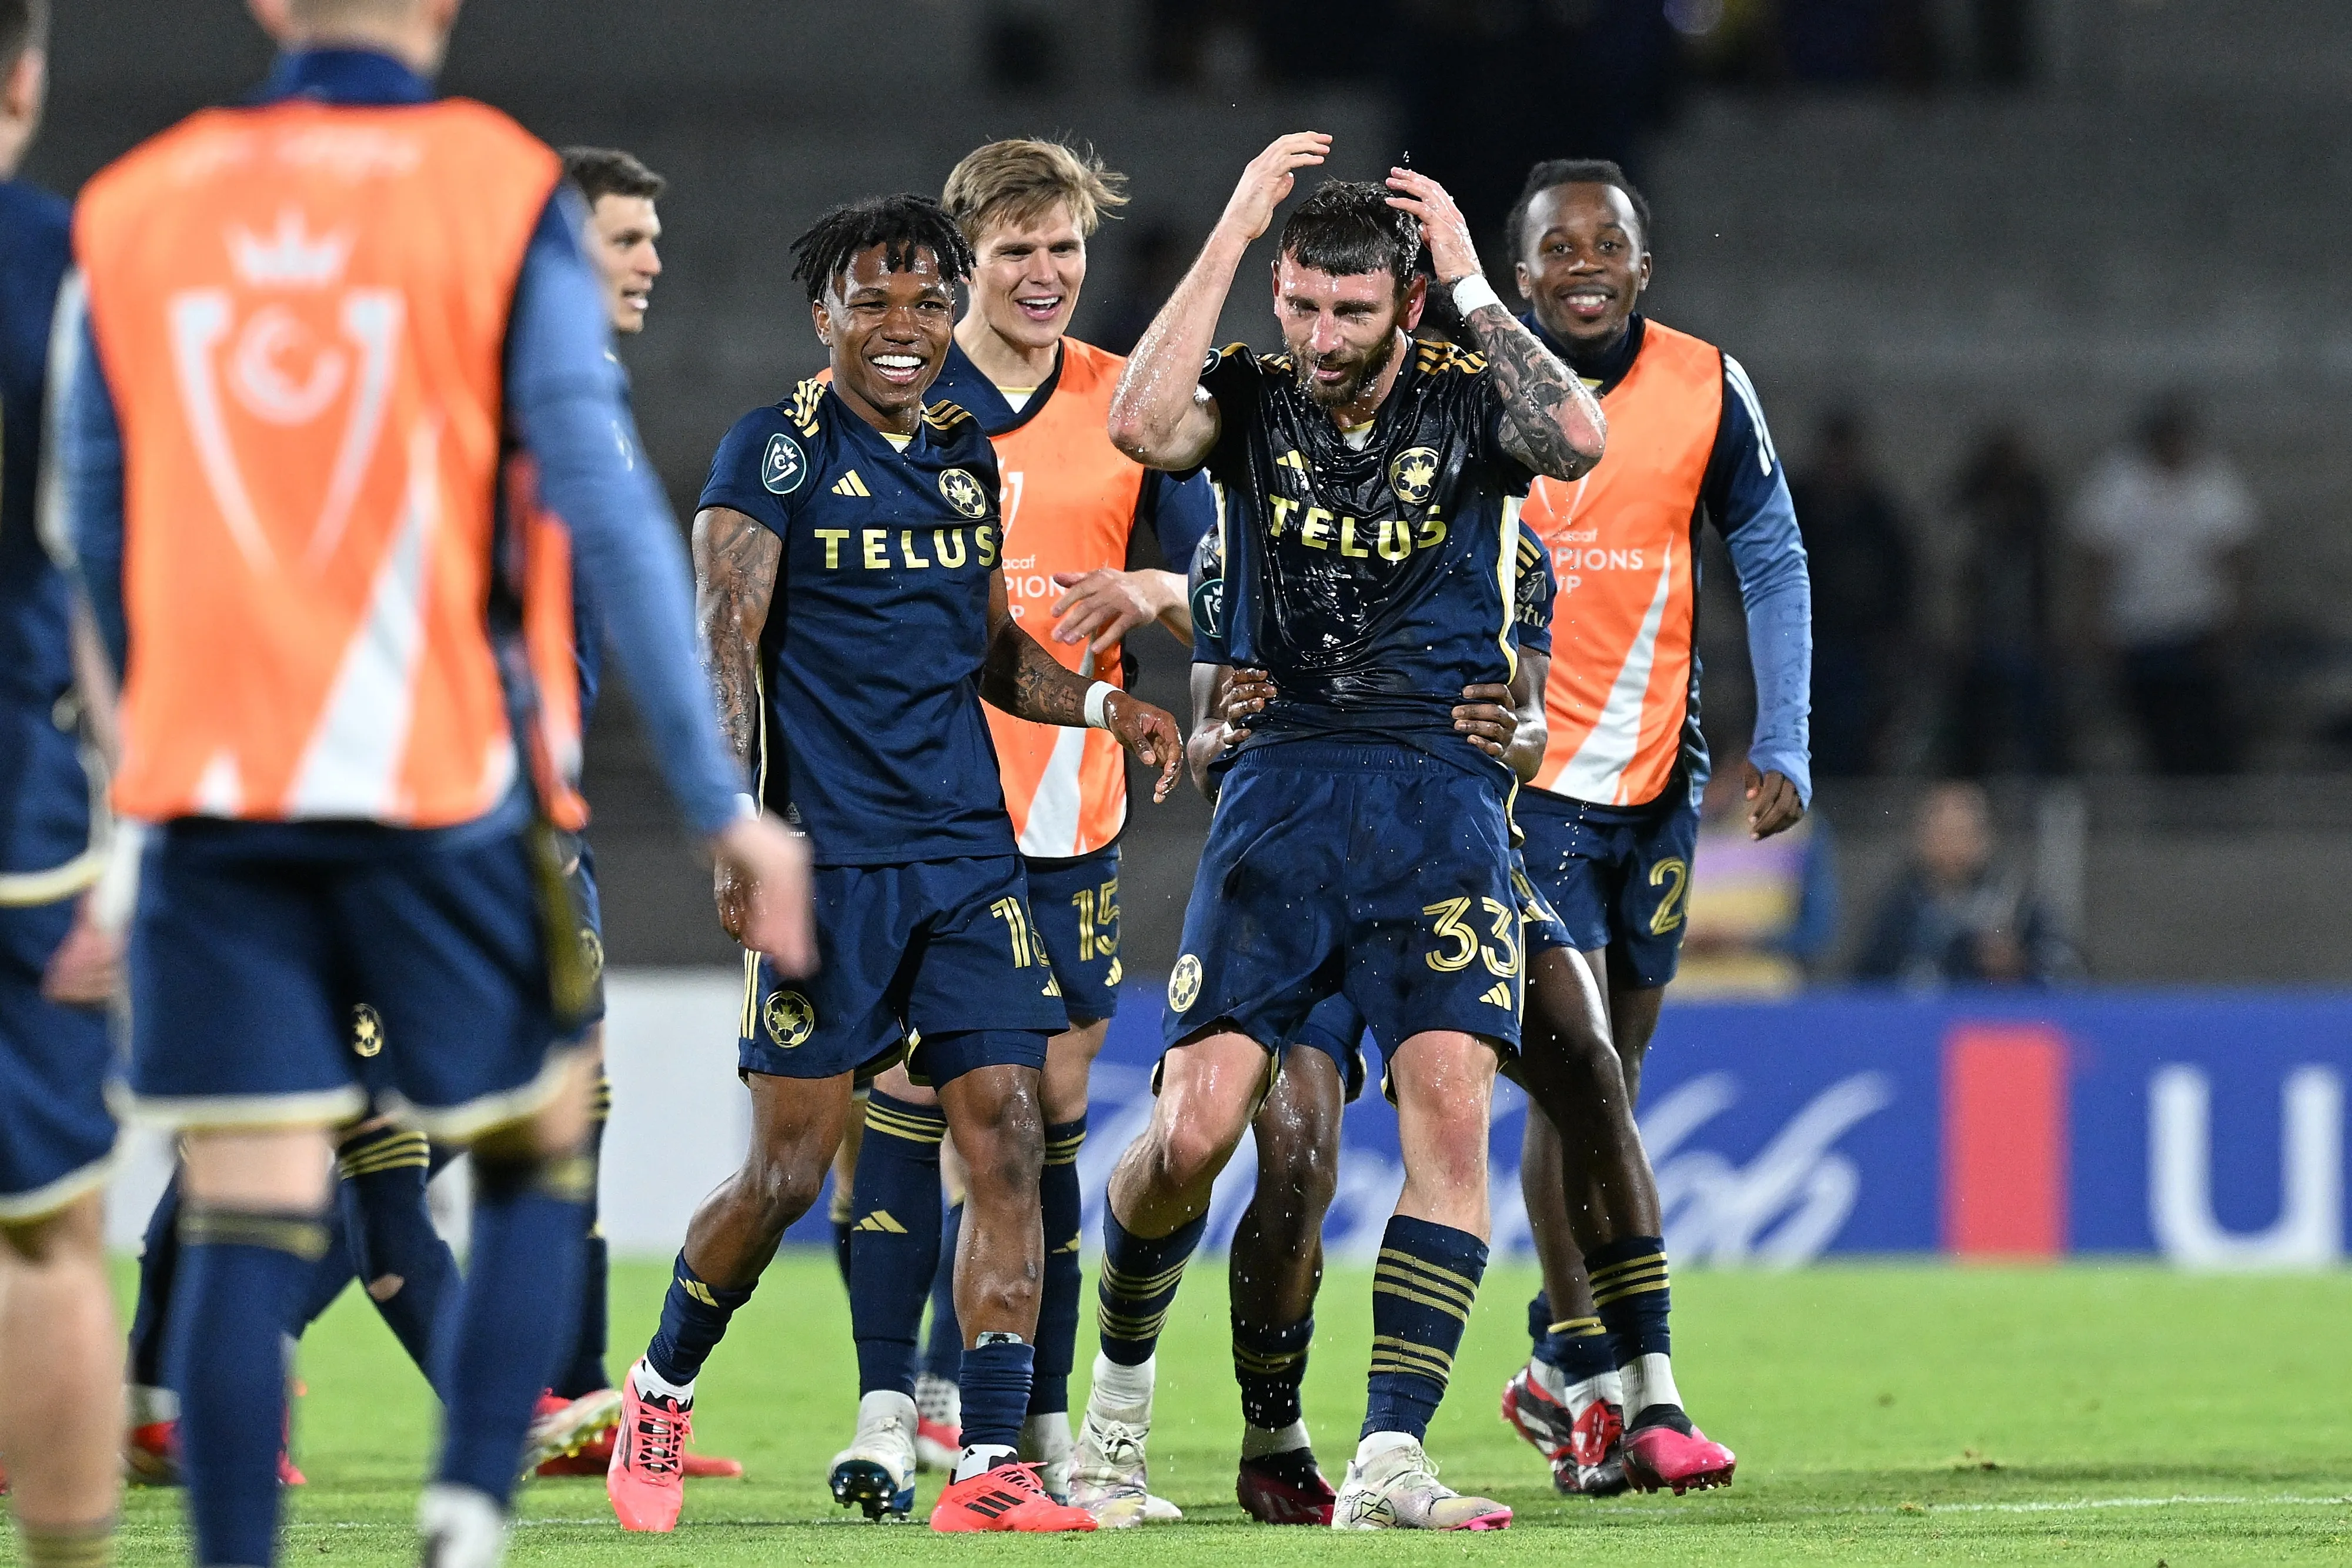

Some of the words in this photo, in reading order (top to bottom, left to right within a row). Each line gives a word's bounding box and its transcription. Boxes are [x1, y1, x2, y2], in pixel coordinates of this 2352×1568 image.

[814, 525, 995, 569] TELUS
[1269, 494, 1447, 561] TELUS
[1072, 877, 1120, 961] 15
[1649, 857, 1689, 936] 2
[1422, 896, 1519, 978] 33
